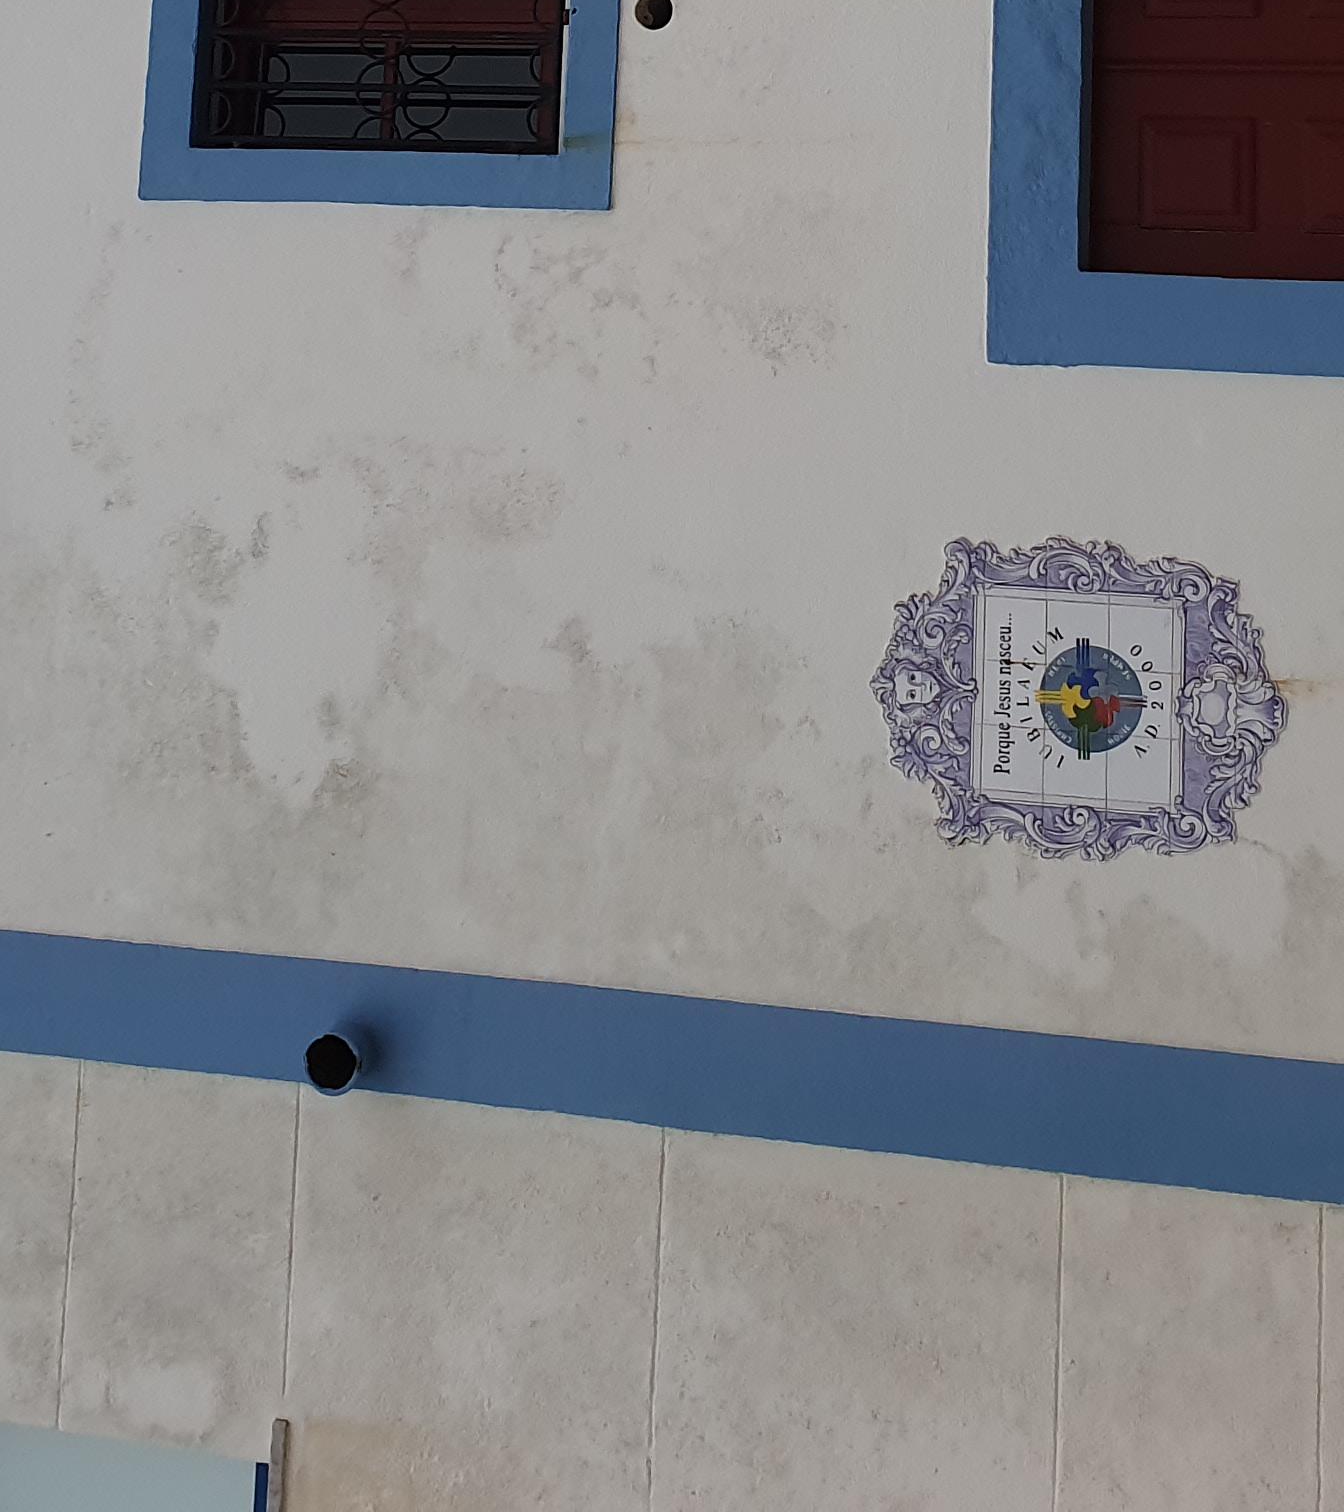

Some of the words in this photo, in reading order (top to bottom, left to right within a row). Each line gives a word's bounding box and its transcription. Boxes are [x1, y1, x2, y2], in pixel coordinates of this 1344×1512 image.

[998, 613, 1011, 675] nasceu...
[994, 680, 1011, 718] Jesus
[1130, 644, 1164, 710] 2000
[993, 722, 1015, 774] Porque
